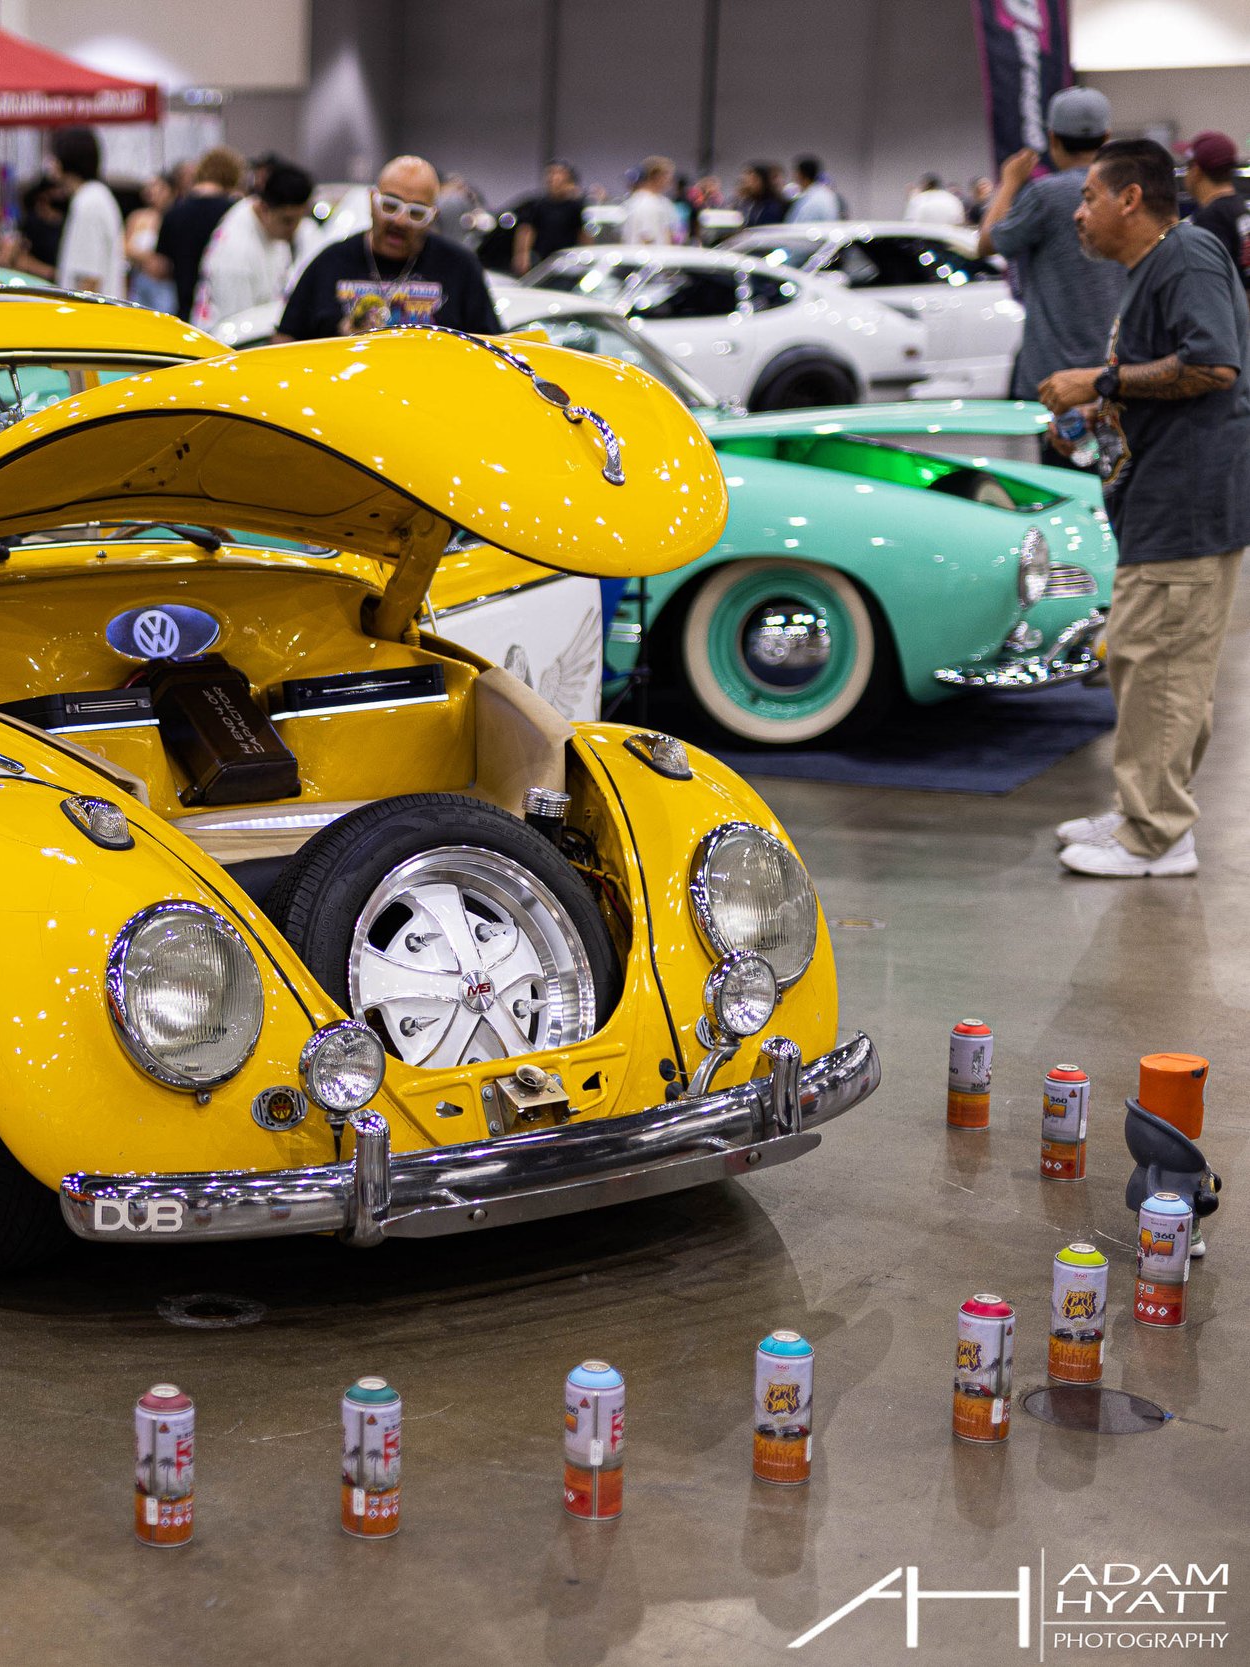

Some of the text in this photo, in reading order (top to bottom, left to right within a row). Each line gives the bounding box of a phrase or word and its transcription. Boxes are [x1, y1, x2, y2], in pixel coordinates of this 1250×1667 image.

[213, 686, 265, 753] CAPACITOR
[222, 717, 245, 741] END
[94, 1199, 184, 1232] DUB
[1153, 1231, 1176, 1240] 360
